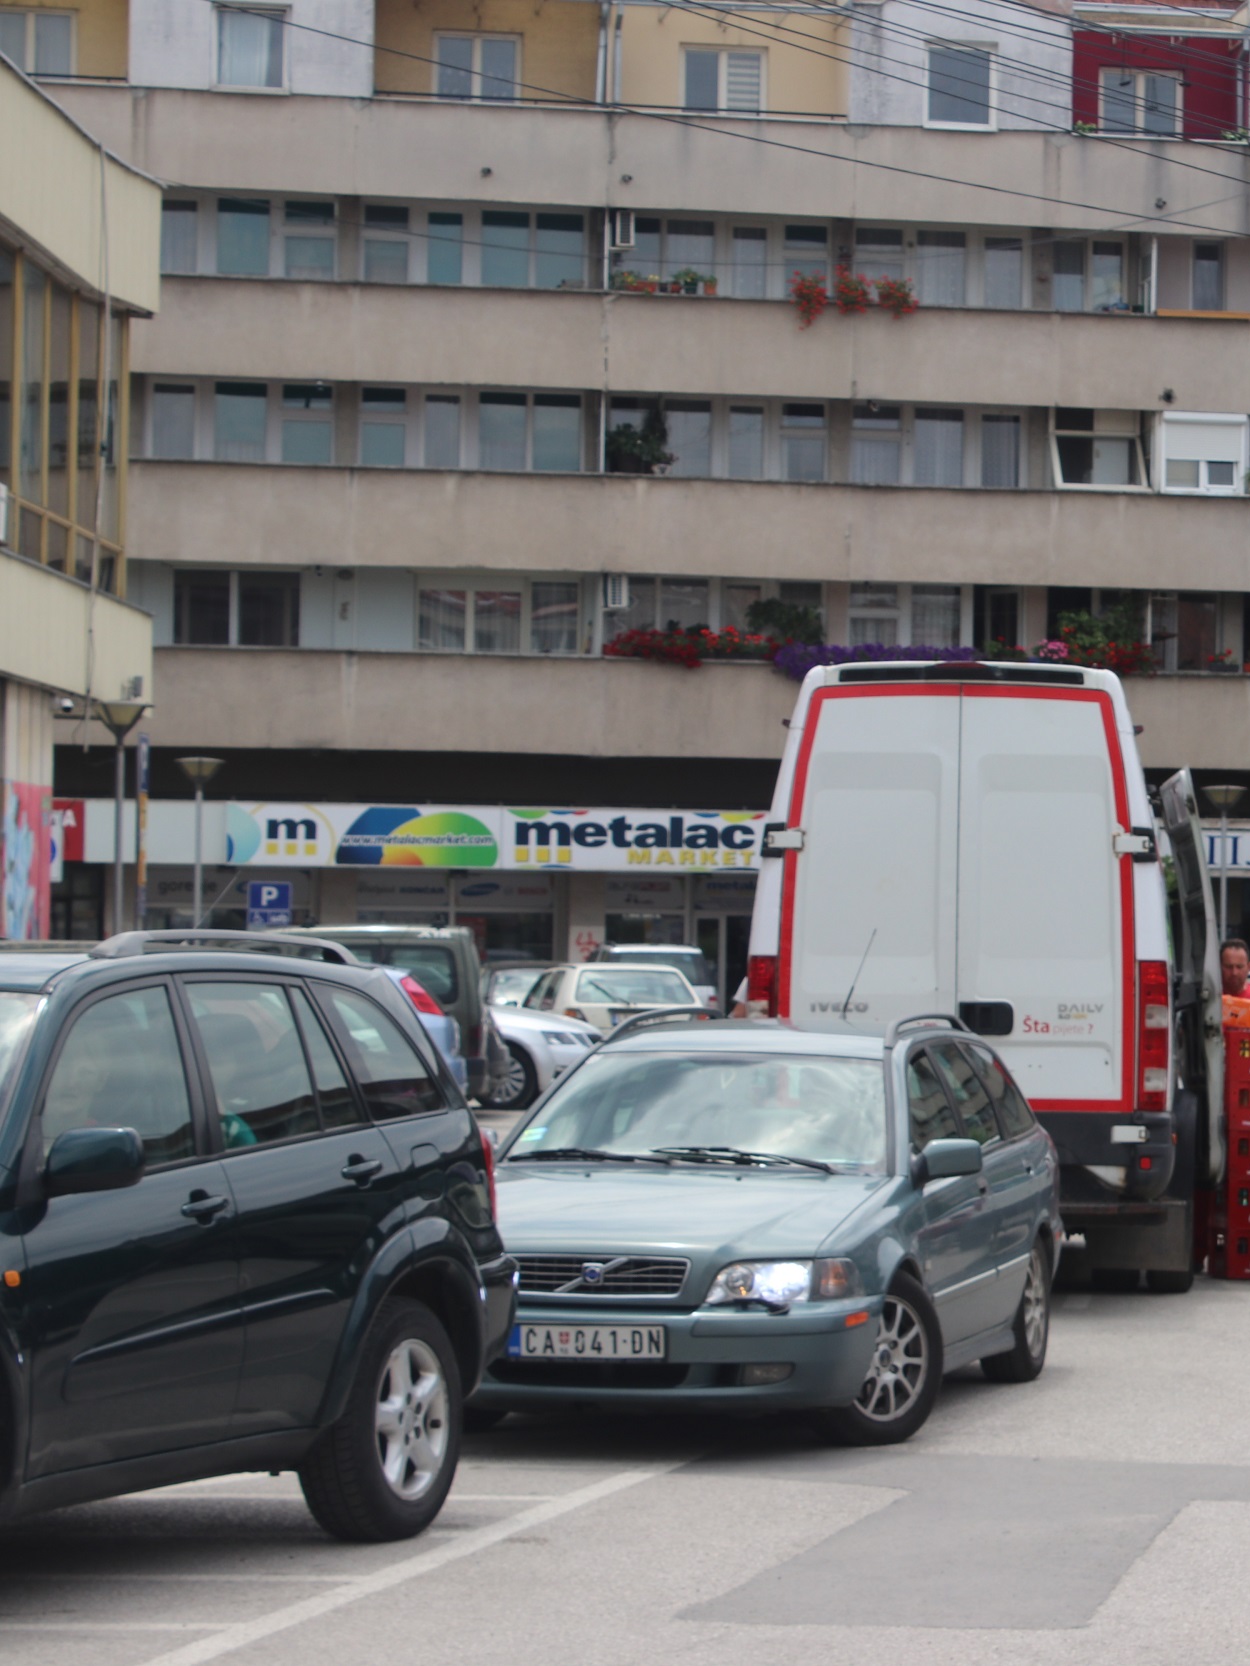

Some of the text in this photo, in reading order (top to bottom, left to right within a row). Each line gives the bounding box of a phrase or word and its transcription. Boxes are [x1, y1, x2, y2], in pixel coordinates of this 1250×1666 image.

[515, 816, 756, 849] metalac
[627, 849, 756, 865] MARKET
[260, 886, 279, 906] P
[1022, 1015, 1050, 1034] Šta
